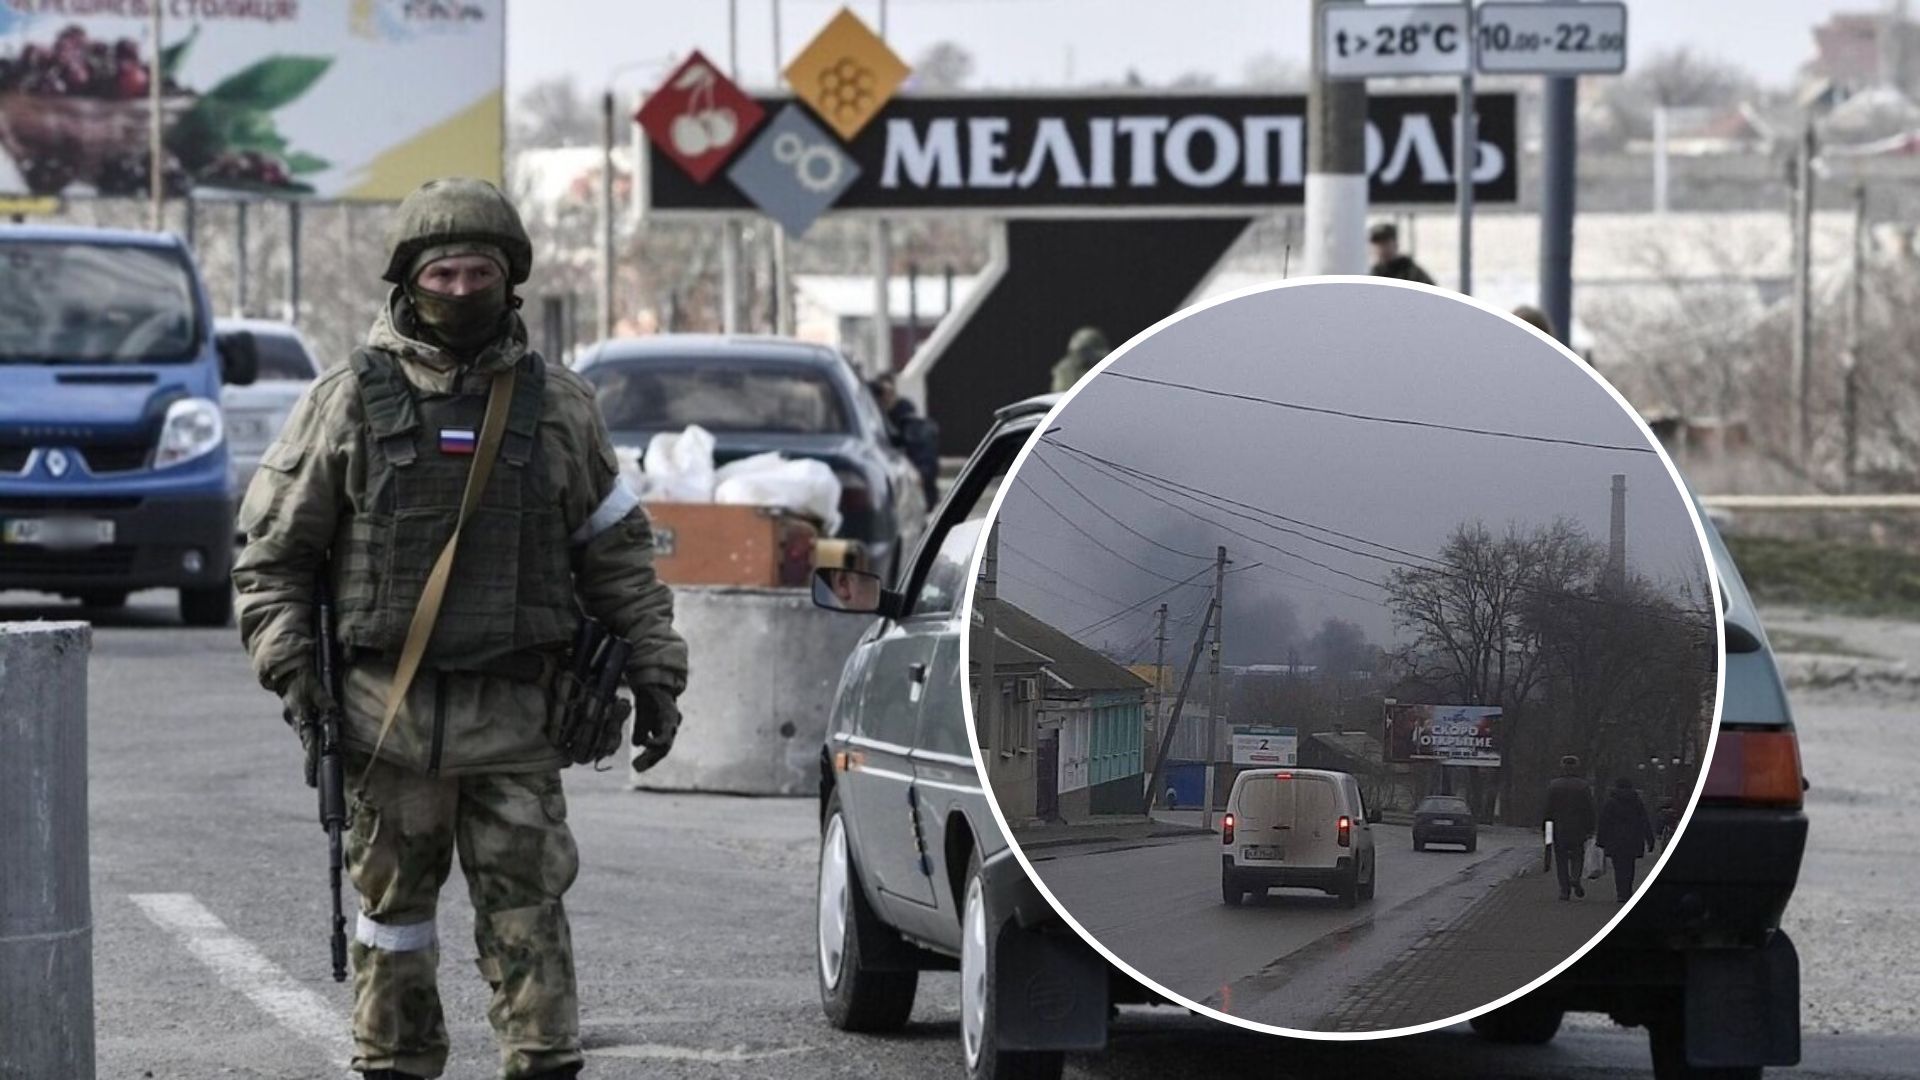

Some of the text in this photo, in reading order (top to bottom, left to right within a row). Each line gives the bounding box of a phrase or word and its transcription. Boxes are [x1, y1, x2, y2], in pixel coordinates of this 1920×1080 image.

[880, 115, 1505, 188] МЕЛІТОПЛЬ
[1431, 724, 1479, 737] СКОРО
[1420, 735, 1493, 748] ОТКРЫТИЕ
